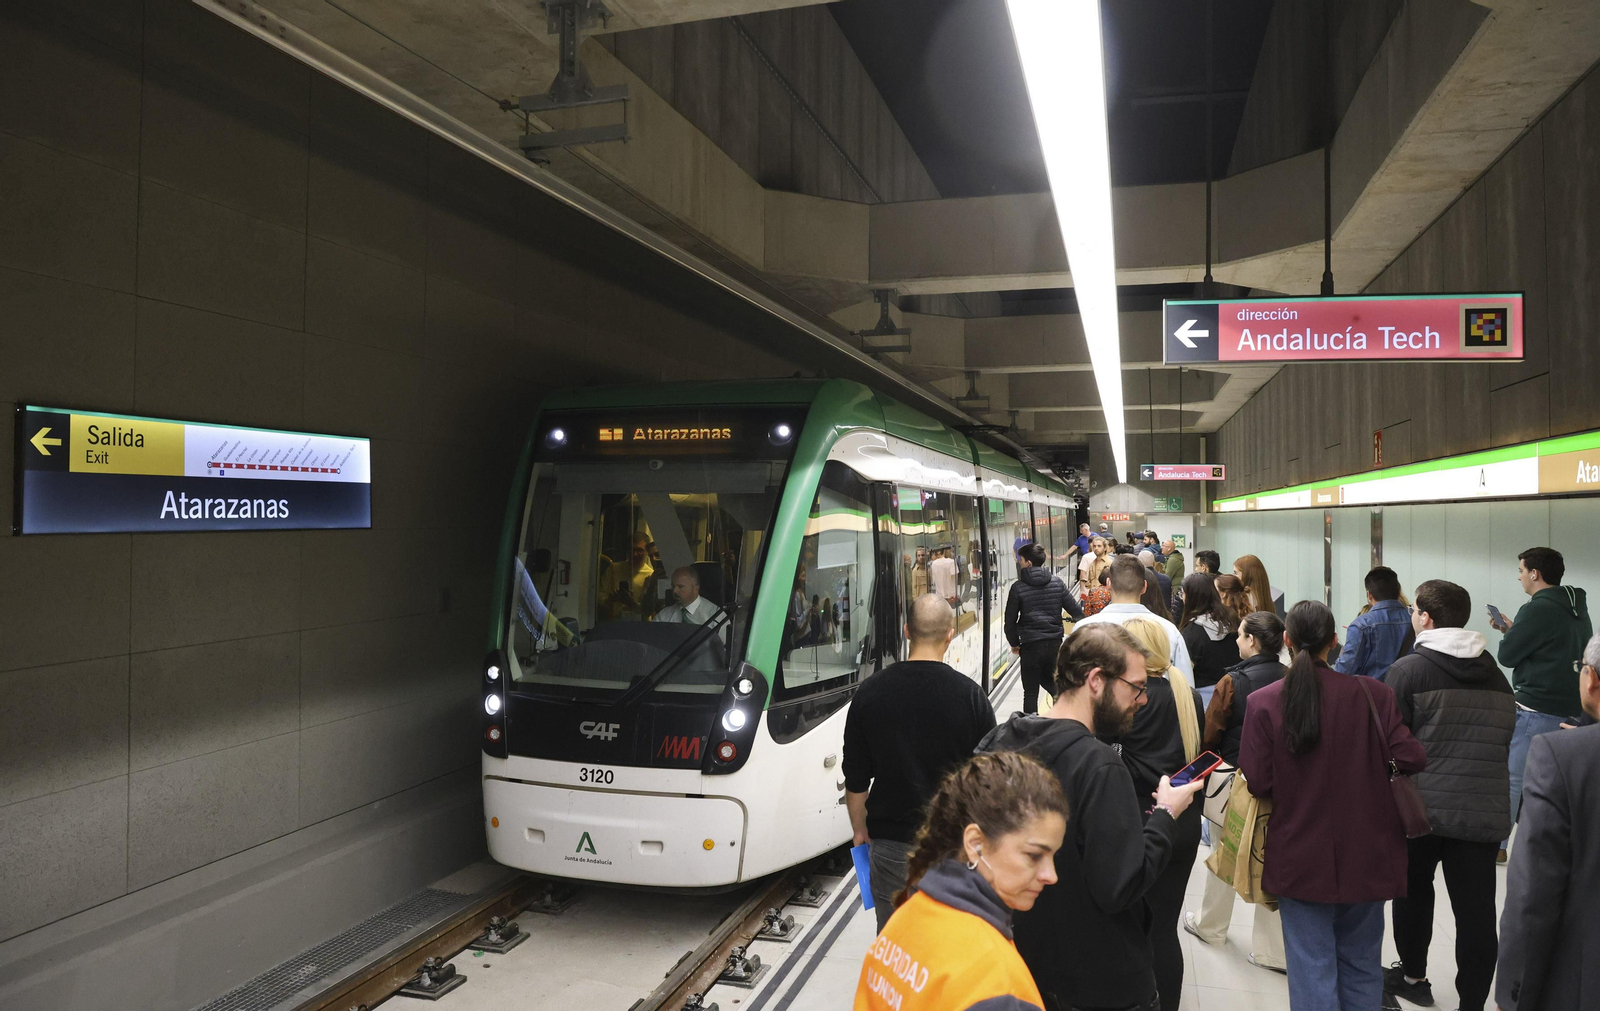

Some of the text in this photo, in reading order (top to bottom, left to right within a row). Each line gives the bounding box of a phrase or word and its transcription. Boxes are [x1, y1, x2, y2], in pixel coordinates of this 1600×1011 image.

[1237, 308, 1298, 321] dirección
[1237, 326, 1440, 350] Andalucía Tech
[87, 424, 144, 448] Salida
[633, 427, 731, 440] Atarazanas
[86, 449, 109, 465] Exit
[1576, 460, 1600, 483] Ata
[160, 490, 290, 519] Atarazanas
[579, 721, 620, 741] CAF
[579, 767, 614, 785] 3120
[587, 858, 613, 866] Andalucía
